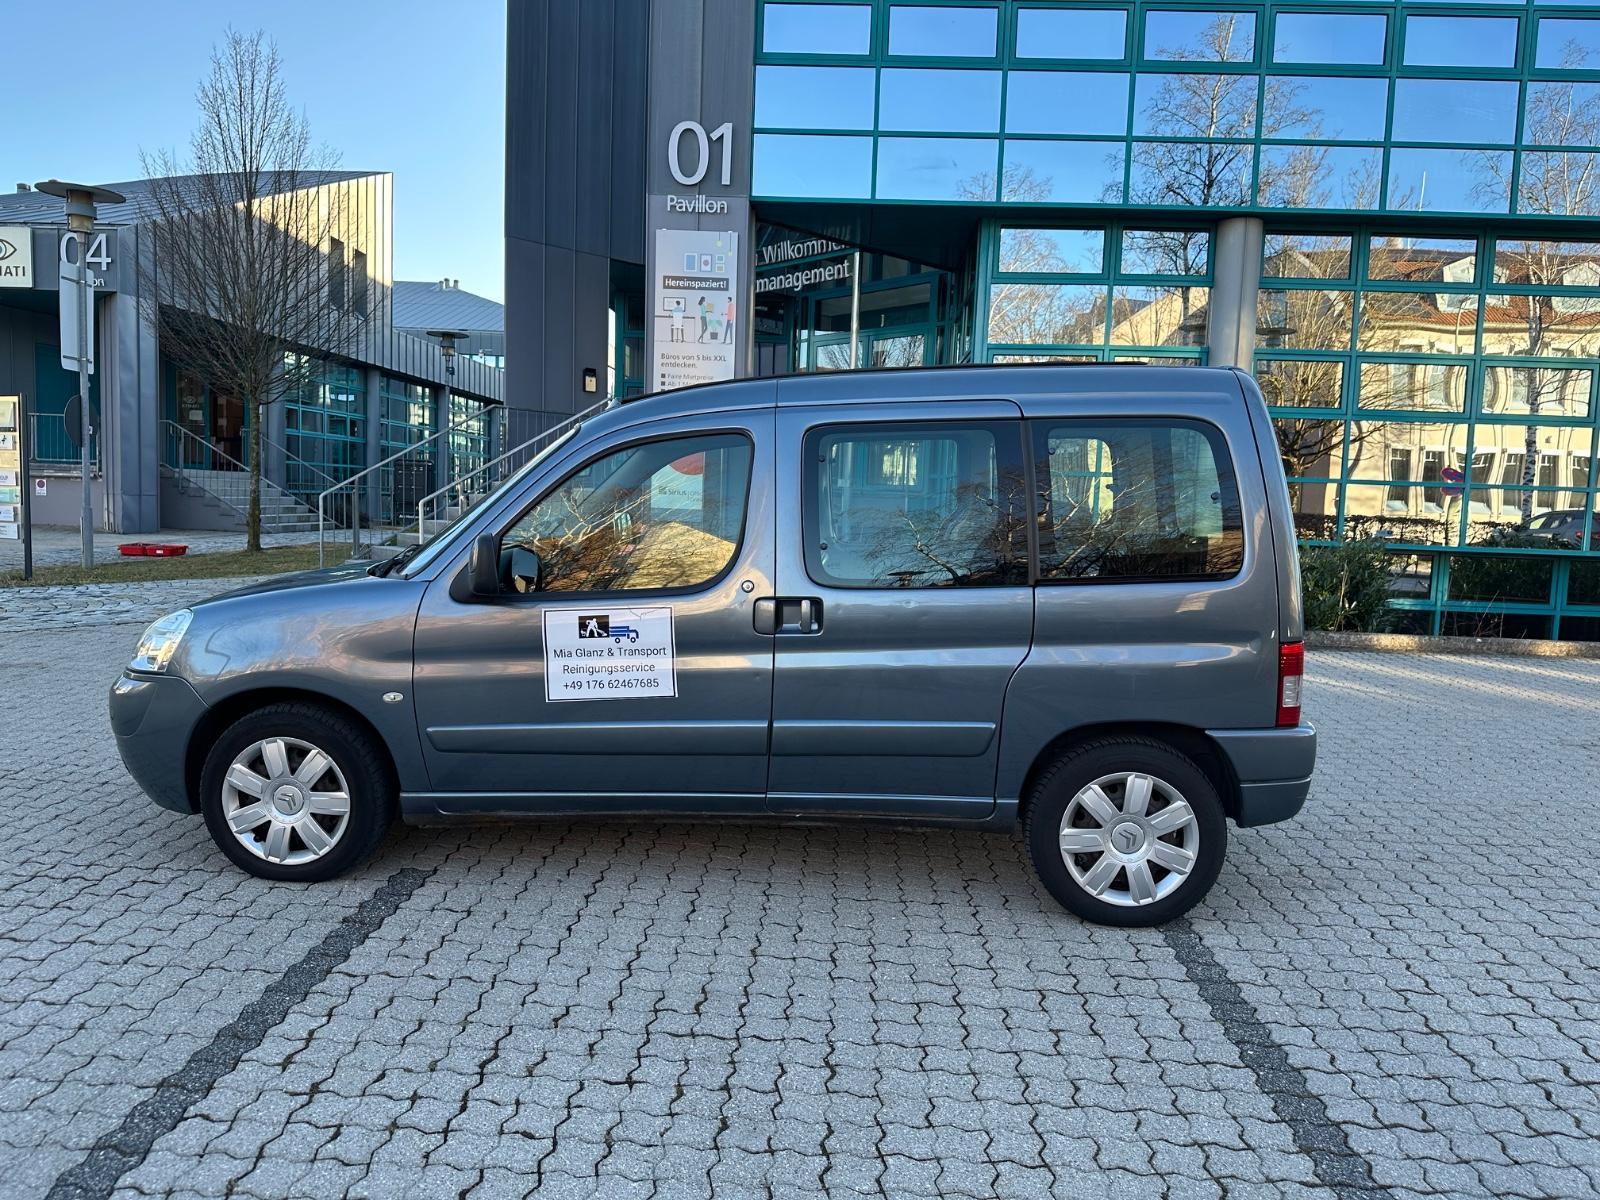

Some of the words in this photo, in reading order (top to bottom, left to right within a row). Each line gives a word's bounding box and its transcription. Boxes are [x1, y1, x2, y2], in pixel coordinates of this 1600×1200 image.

[668, 120, 733, 186] 01
[667, 194, 728, 213] Pavillon
[0, 265, 26, 277] ATI
[756, 259, 850, 293] management
[665, 278, 727, 289] Hereinspaziert!
[660, 352, 680, 360] Büros
[660, 361, 698, 369] entdecken.
[553, 649, 573, 658] Mia
[575, 648, 604, 658] Glanz
[607, 647, 615, 656] &
[617, 647, 667, 658] Transport
[562, 663, 656, 675] Reinigungsservice
[563, 680, 583, 690] +49
[586, 679, 605, 689] 176
[607, 678, 659, 689] 62467685
